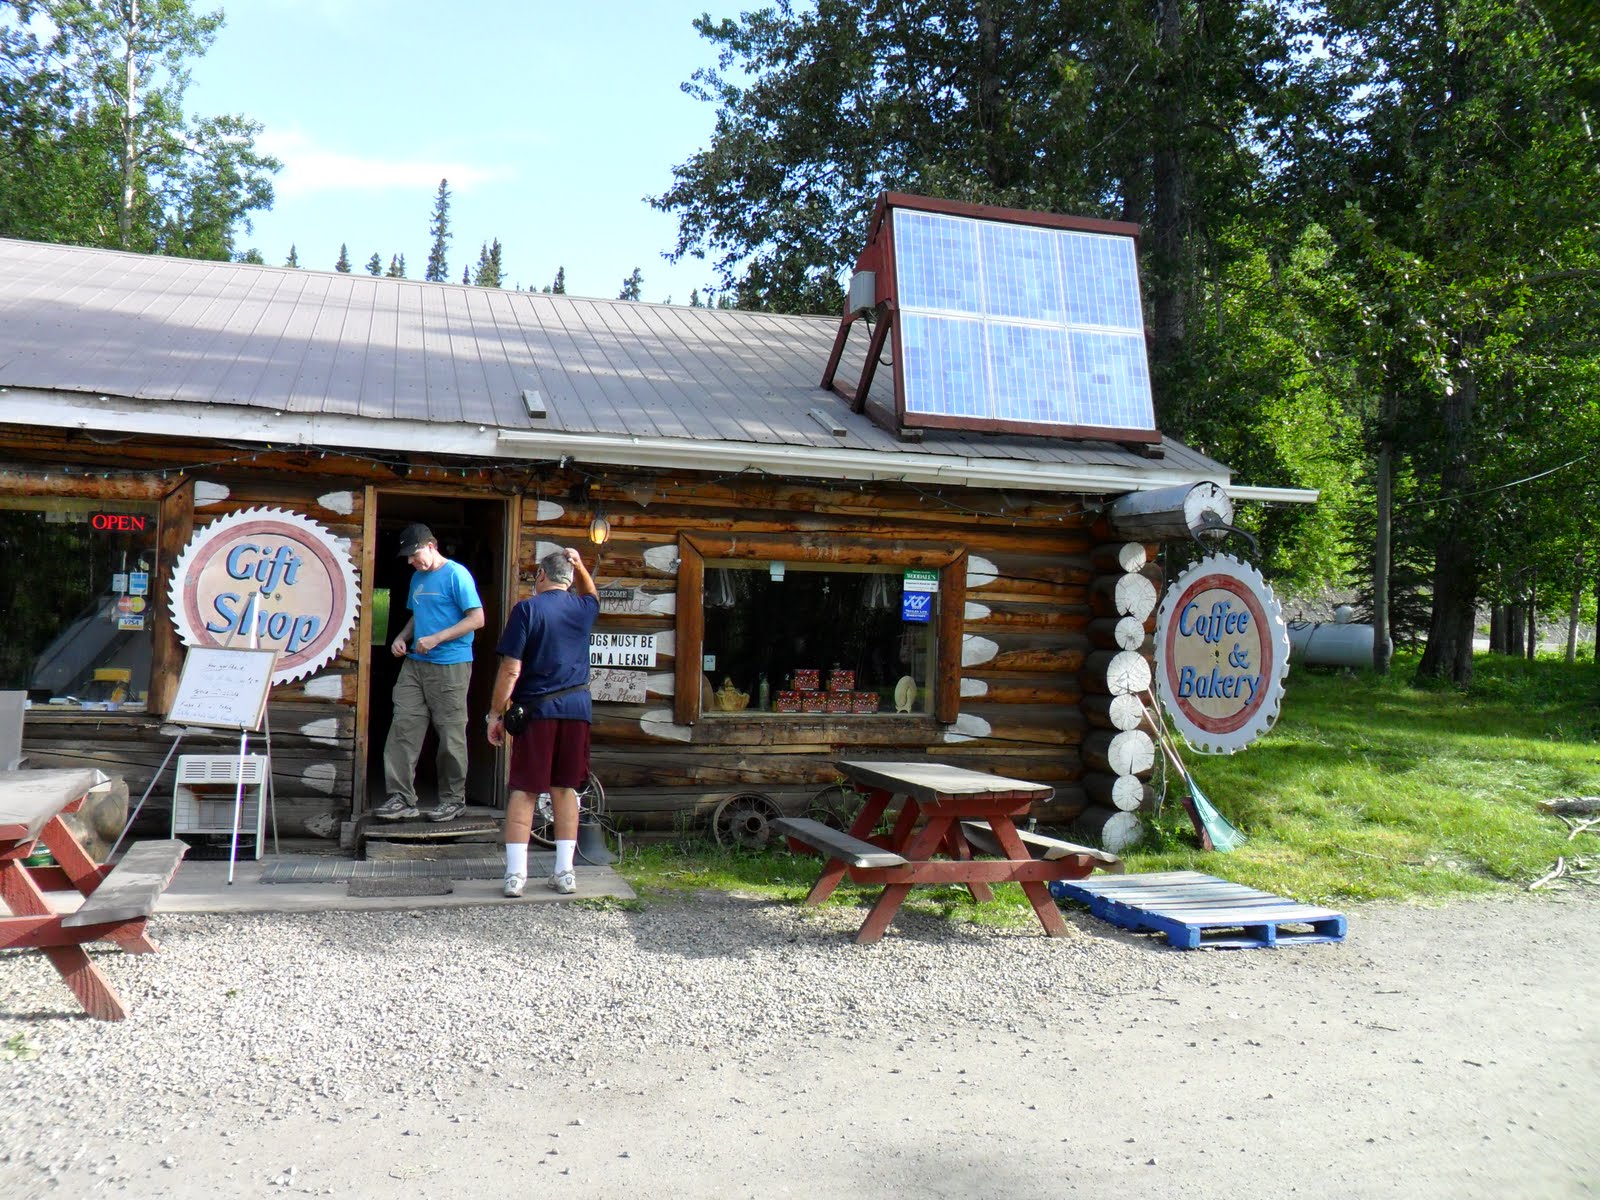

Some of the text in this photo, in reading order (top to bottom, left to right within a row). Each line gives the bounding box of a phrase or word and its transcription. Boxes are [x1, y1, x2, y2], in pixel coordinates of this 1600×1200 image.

[92, 514, 145, 531] OPEN
[226, 543, 302, 595] Gift
[598, 590, 628, 598] ELCOME
[206, 592, 321, 654] Shop
[1179, 601, 1250, 643] Coffee
[590, 634, 654, 648] OGS MUST BE
[590, 652, 649, 665] ON A LEASH
[1228, 642, 1250, 669] &
[1178, 665, 1264, 705] Bakery
